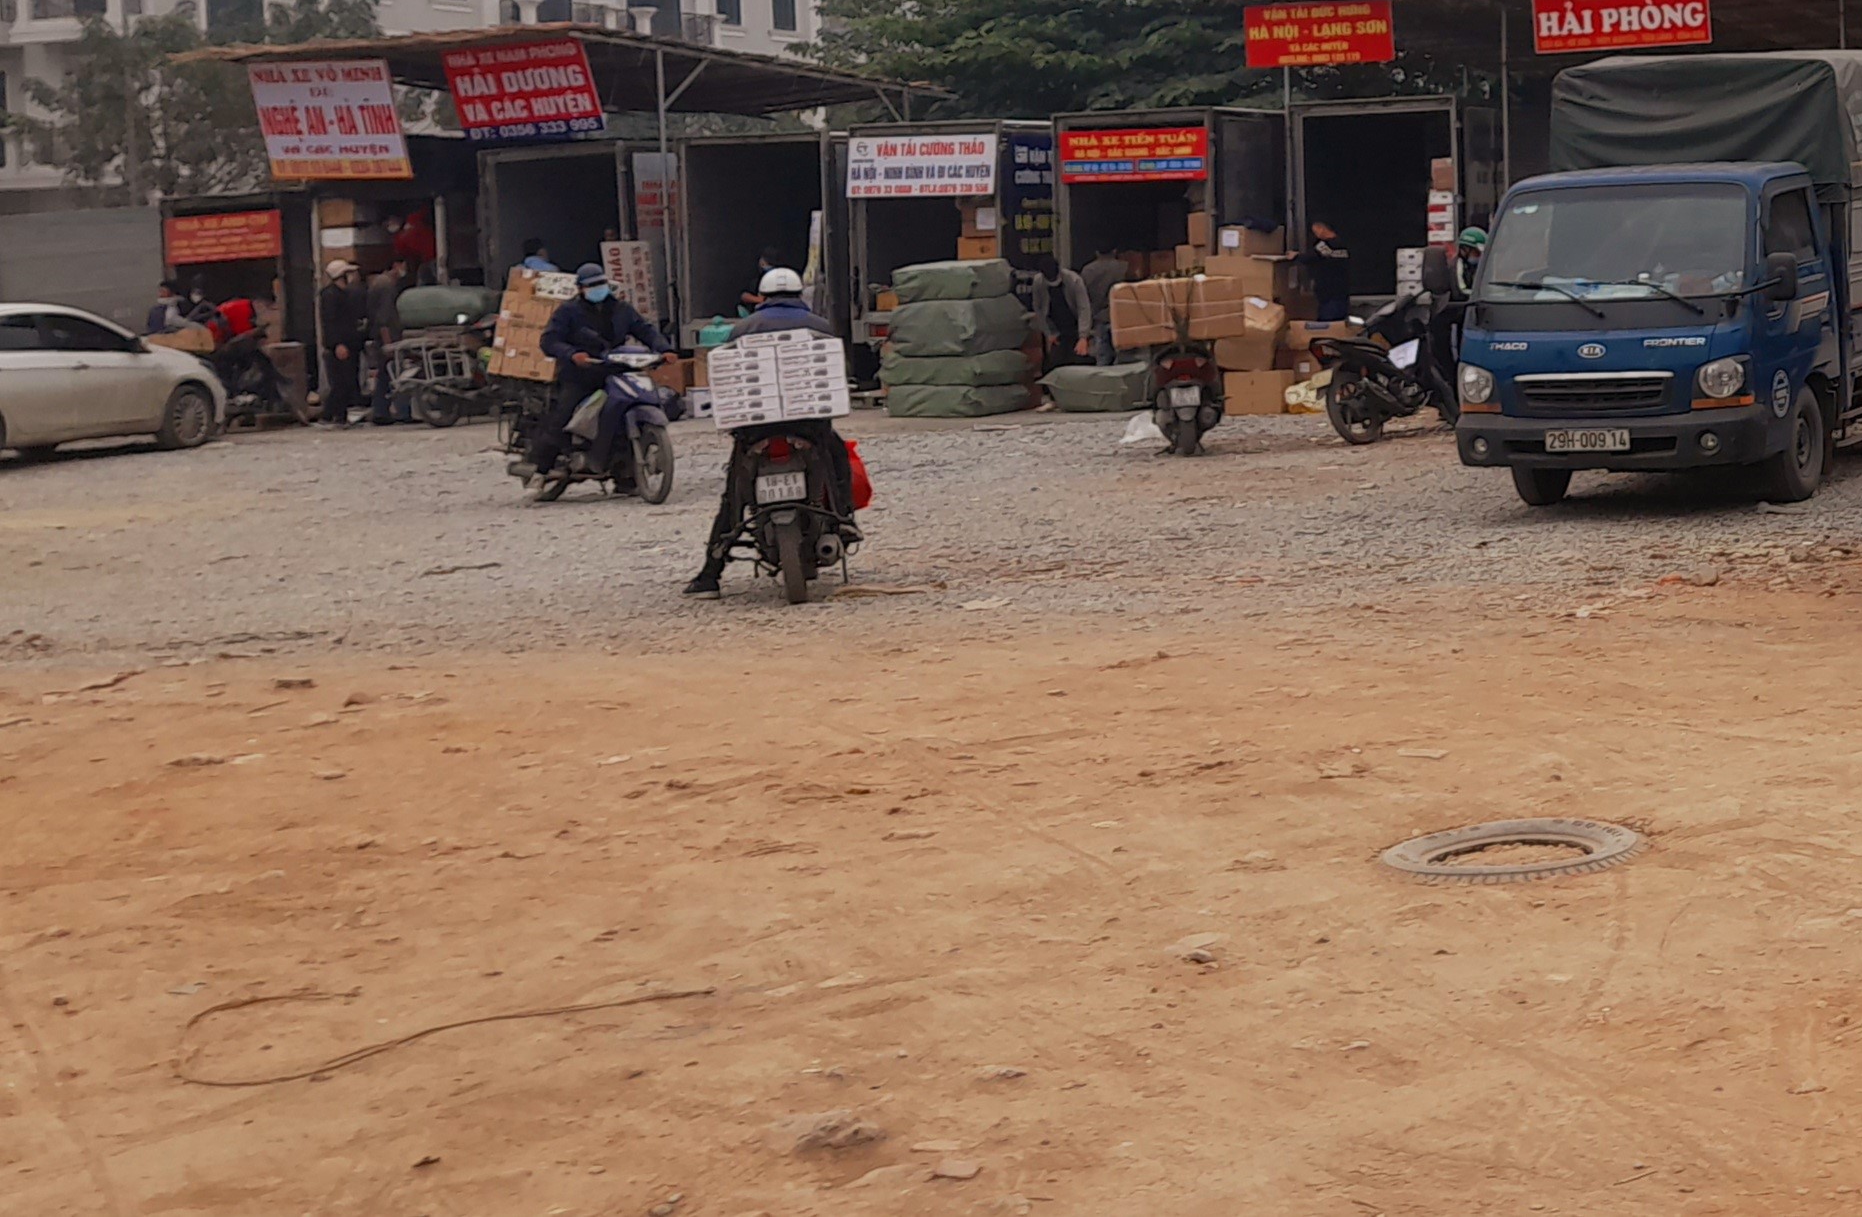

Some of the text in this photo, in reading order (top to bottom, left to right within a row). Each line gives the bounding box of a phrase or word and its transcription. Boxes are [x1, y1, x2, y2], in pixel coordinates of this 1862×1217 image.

[1538, 0, 1594, 37] HẢI
[1249, 23, 1269, 40] HÀ
[1272, 22, 1299, 41] NỘI
[1312, 22, 1353, 39] LẠNG
[1355, 19, 1388, 35] SƠN
[455, 64, 585, 97] HẢI DƯƠNG
[462, 90, 593, 123] VÀ CÁC HUYỆN
[259, 99, 304, 142] NGHỆ
[304, 105, 327, 135] AN
[334, 98, 358, 135] HÀ
[877, 139, 897, 160] VẬN
[901, 138, 916, 156] TẢI
[958, 137, 985, 155] THẢO
[1069, 134, 1098, 146] NHÀ
[1102, 135, 1120, 145] XE
[851, 164, 861, 180] HÀ
[947, 162, 963, 178] CÁC
[1489, 342, 1527, 351] THACO
[1582, 346, 1601, 356] KIA
[1643, 337, 1706, 348] FRONTIER
[1548, 434, 1627, 449] 29H-009.14
